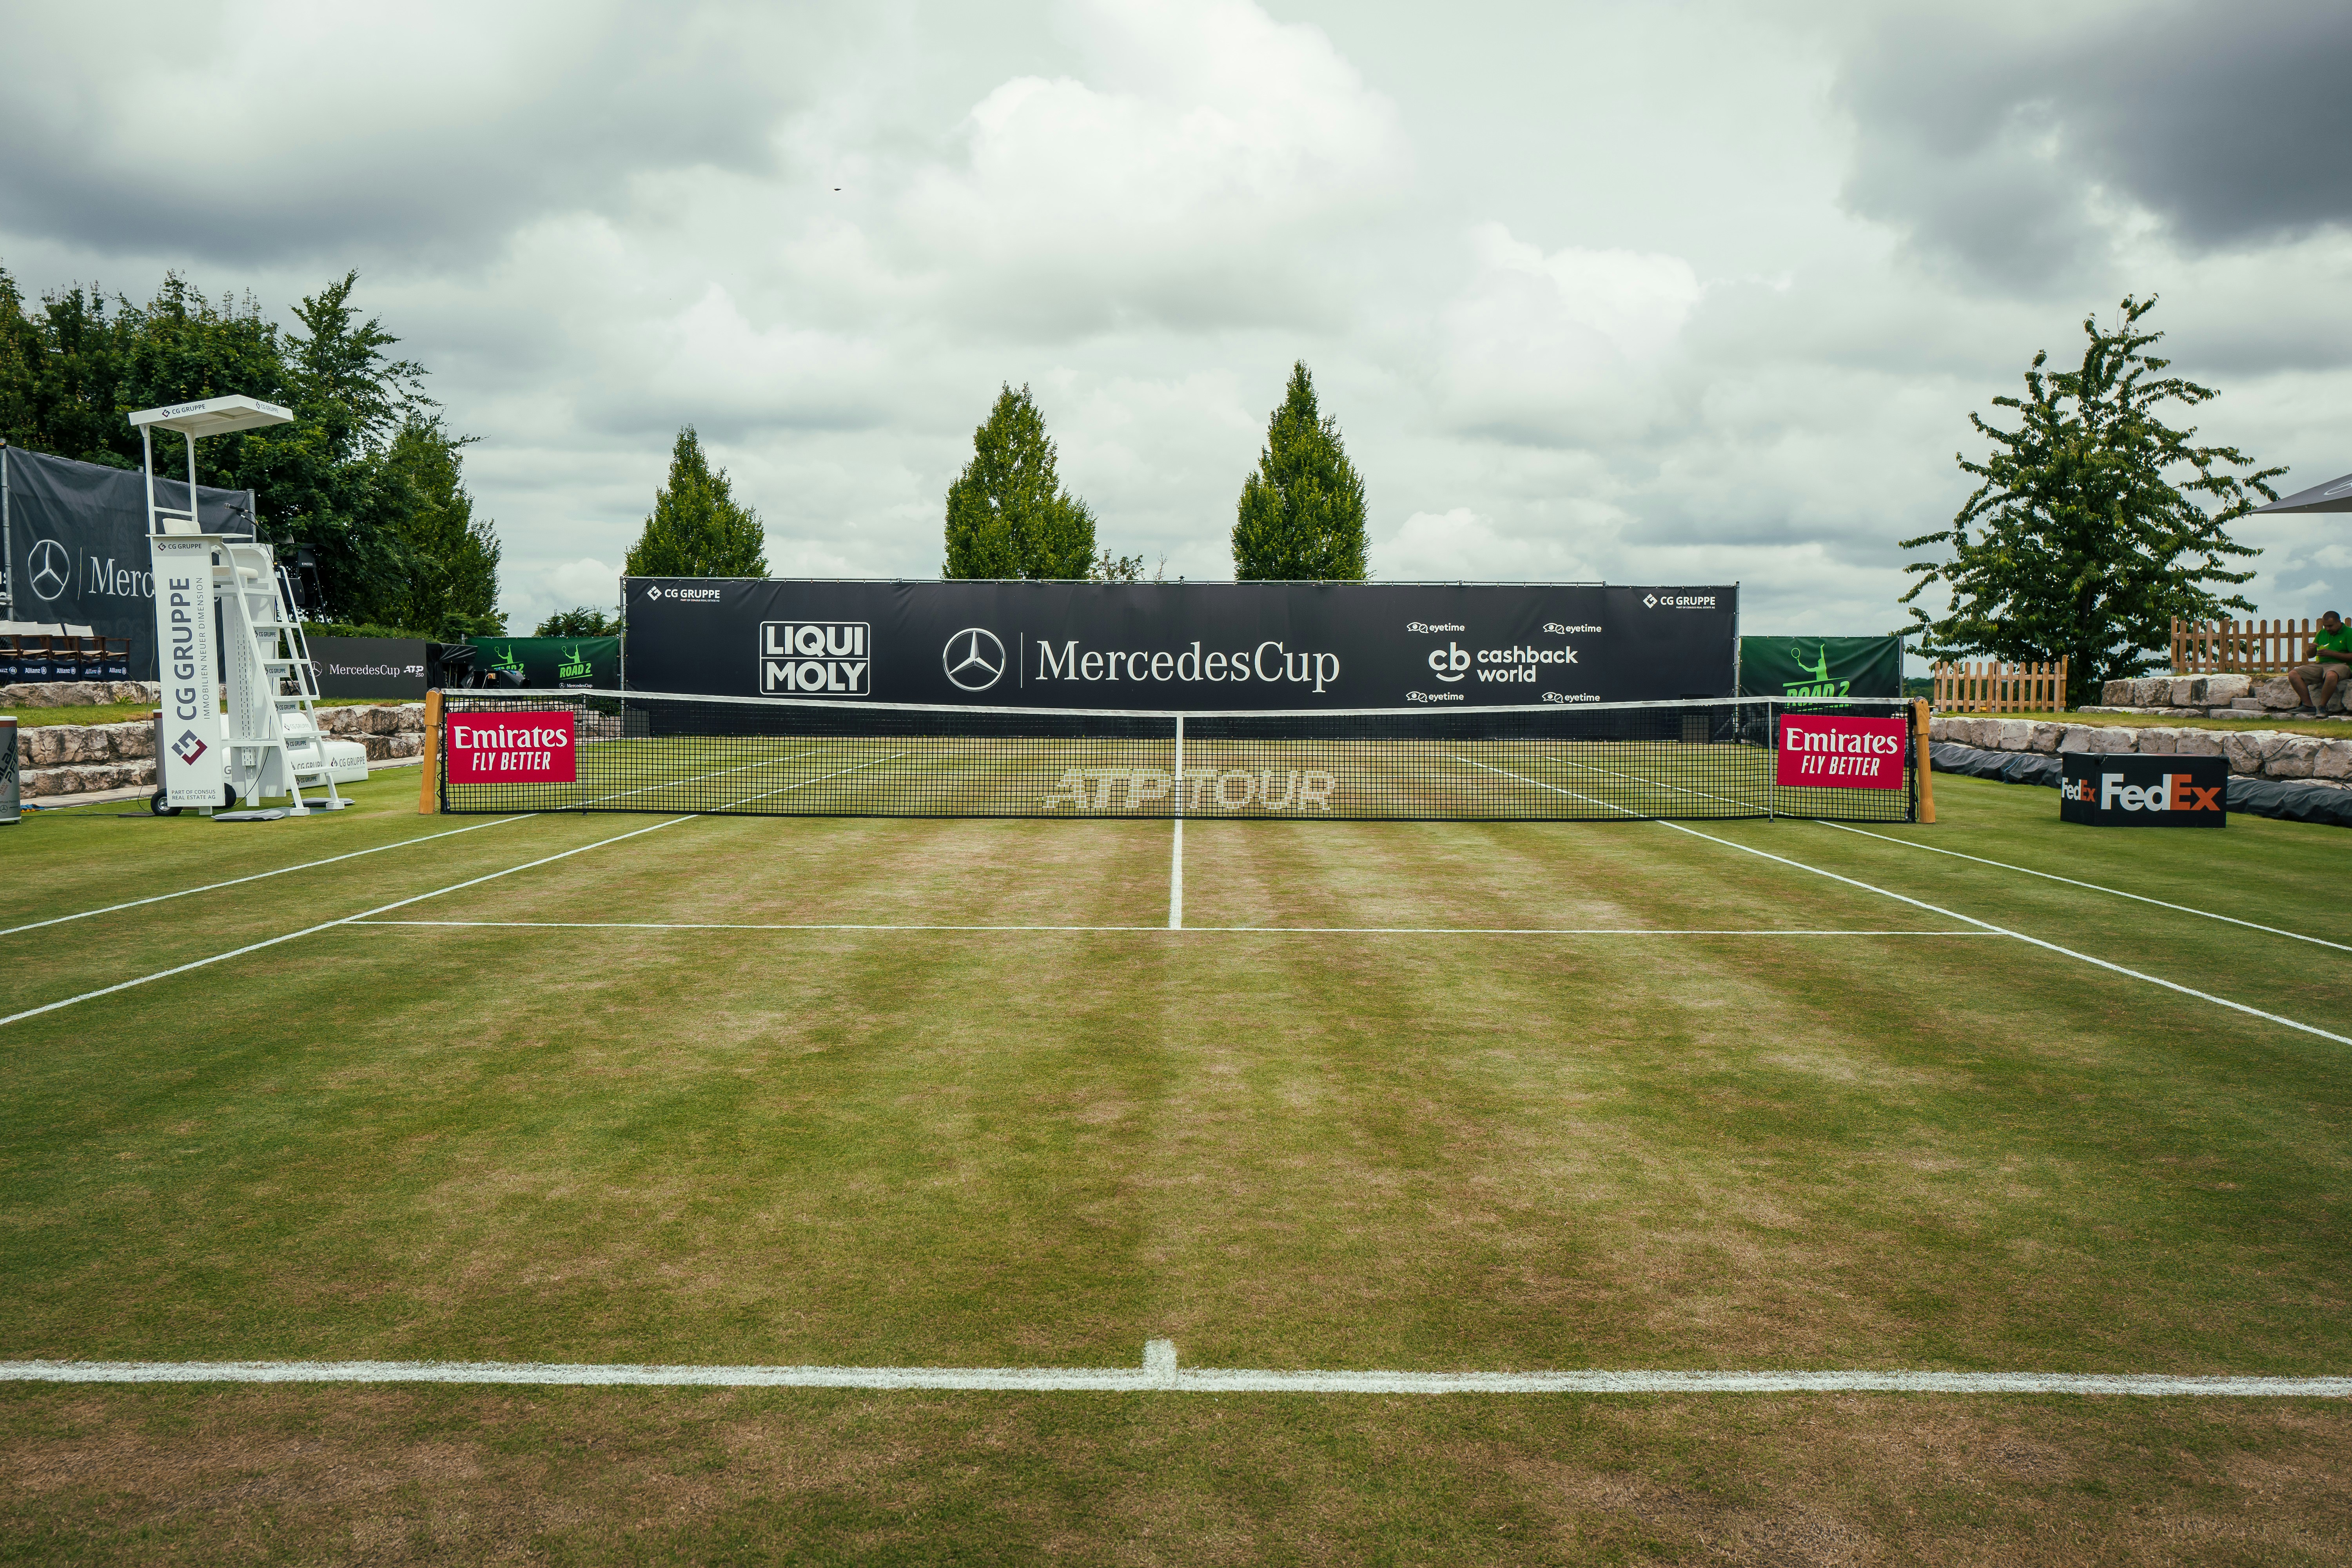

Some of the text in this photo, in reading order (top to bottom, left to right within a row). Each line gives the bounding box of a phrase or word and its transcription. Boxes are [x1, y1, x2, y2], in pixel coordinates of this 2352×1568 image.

[181, 404, 206, 413] GRUPPE
[196, 578, 205, 629] DIMENSION
[664, 589, 720, 599] CG GRUPPE
[1660, 596, 1715, 605] CG GRUPPE
[1429, 622, 1465, 633] eyetime
[1565, 624, 1602, 633] eyetime
[169, 578, 197, 720] CG GRUPPE
[767, 625, 864, 657] LIQUI
[1428, 642, 1470, 671] cb
[1477, 646, 1578, 663] cashback
[329, 664, 400, 677] MercedesCup
[560, 663, 591, 678] ROAD 2
[767, 661, 866, 691] MOLY
[1035, 641, 1340, 693] MercedesCup
[1477, 665, 1536, 682] world
[201, 665, 210, 719] IMMOBILIEN
[1428, 692, 1464, 702] eyetime
[1564, 693, 1600, 703] eyetime
[1838, 681, 1850, 697] 2
[454, 724, 568, 749] Emirates
[1786, 728, 1898, 754] Emirates
[339, 756, 365, 767] CG GRUPPE
[472, 751, 551, 771] FLY BETTER
[1801, 755, 1880, 776] FLY BETTER
[1036, 768, 1335, 811] ATP TOUR
[2061, 777, 2096, 802] FedEx
[2101, 773, 2221, 811] FedEx
